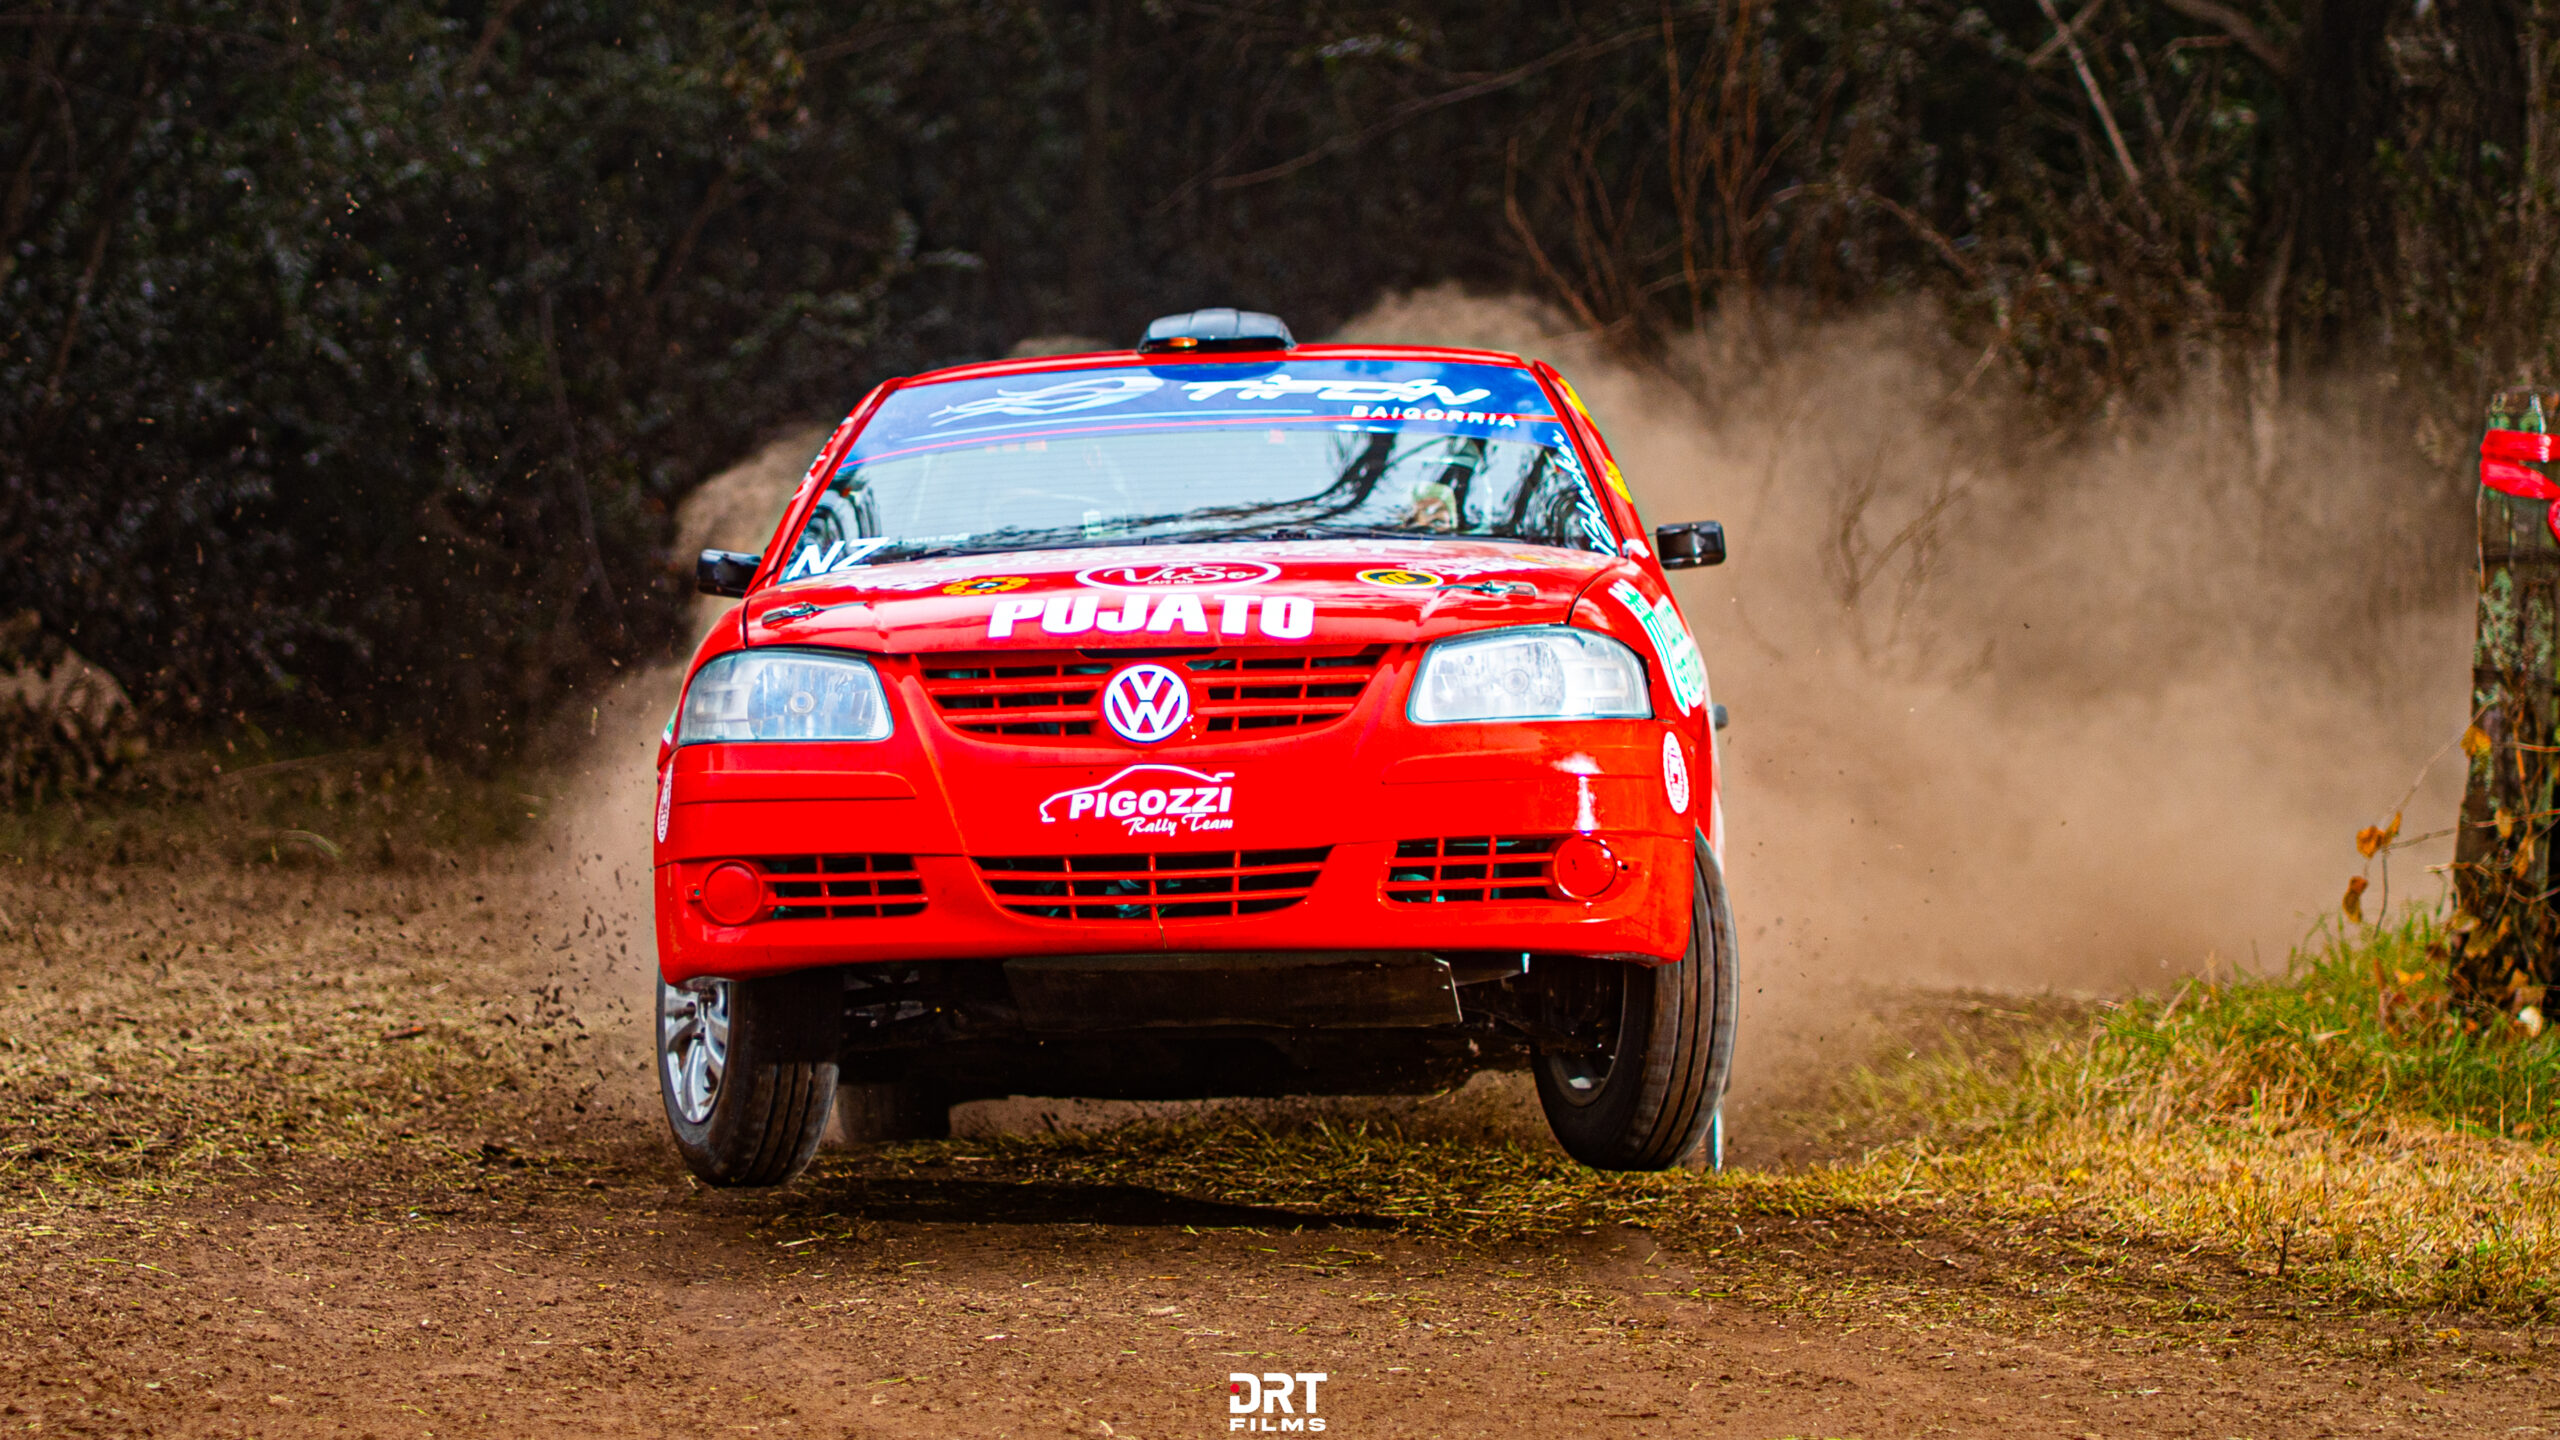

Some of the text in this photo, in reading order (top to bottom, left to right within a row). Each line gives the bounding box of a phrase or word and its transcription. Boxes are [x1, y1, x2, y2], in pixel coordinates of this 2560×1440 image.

[1351, 405, 1516, 428] BAIGORRIA
[987, 594, 1315, 639] PUJATO
[1108, 668, 1184, 738] VW
[1068, 786, 1233, 820] PIGOZZI
[1121, 813, 1234, 837] Rally Team
